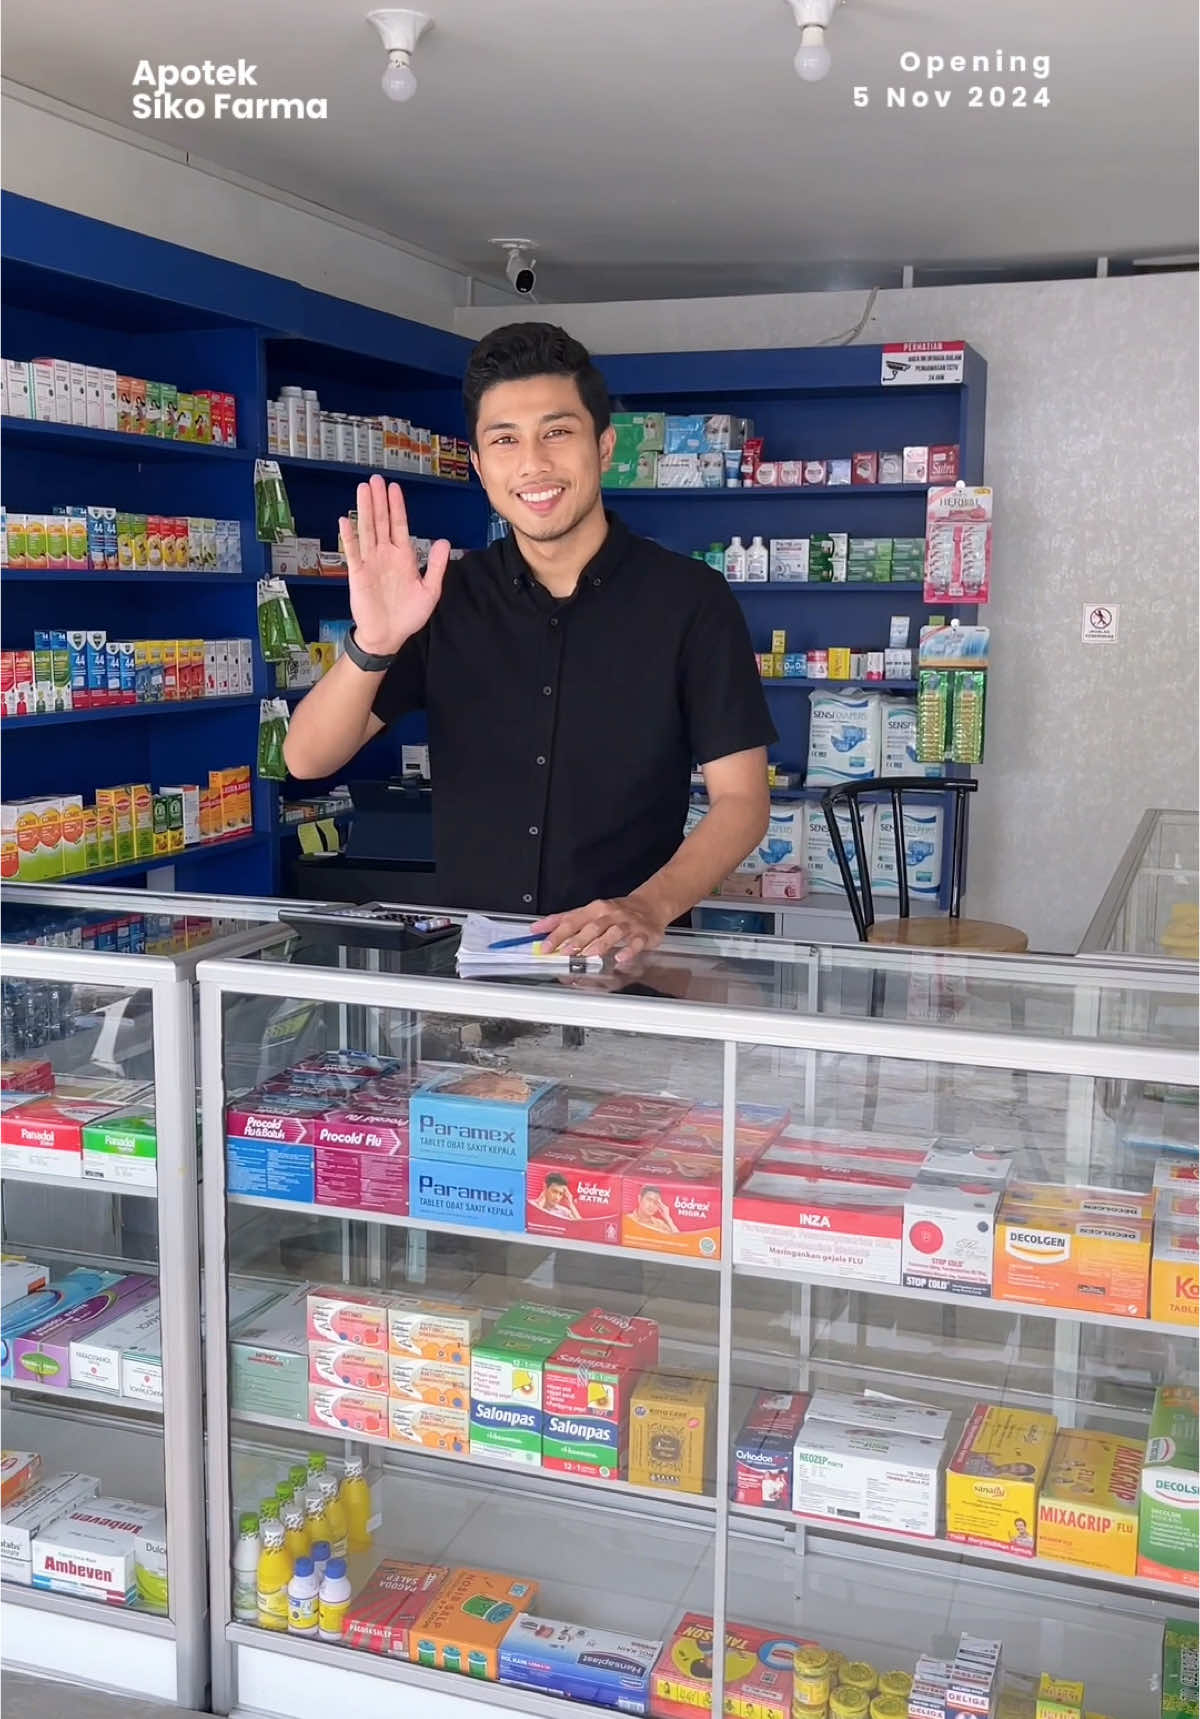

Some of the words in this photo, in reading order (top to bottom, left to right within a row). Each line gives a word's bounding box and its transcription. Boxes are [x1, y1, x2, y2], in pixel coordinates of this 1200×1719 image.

[247, 1116, 283, 1129] Procold
[420, 1115, 515, 1143] Paramex
[21, 1128, 55, 1141] Panadol
[105, 1135, 136, 1147] Panadol
[320, 1129, 362, 1143] Procold
[365, 1133, 382, 1147] Flu
[421, 1137, 445, 1147] TABLET
[419, 1175, 513, 1205] Paramex
[420, 1197, 443, 1208] TABLET
[800, 1213, 831, 1228] INZA
[1010, 1232, 1066, 1248] DECOLGEN
[906, 1276, 927, 1287] STOP
[928, 1278, 948, 1290] COLD
[475, 1403, 536, 1427] Salonpas
[549, 1417, 612, 1441] Salonpas
[800, 1453, 828, 1465] NEOZEP
[1040, 1505, 1112, 1533] MIXAGRIP
[1116, 1522, 1134, 1533] FLU
[44, 1555, 113, 1582] Ambeven
[582, 1653, 643, 1675] Hansaplast
[948, 1692, 986, 1706] GELIGA
[911, 1707, 943, 1717] GELIGA
